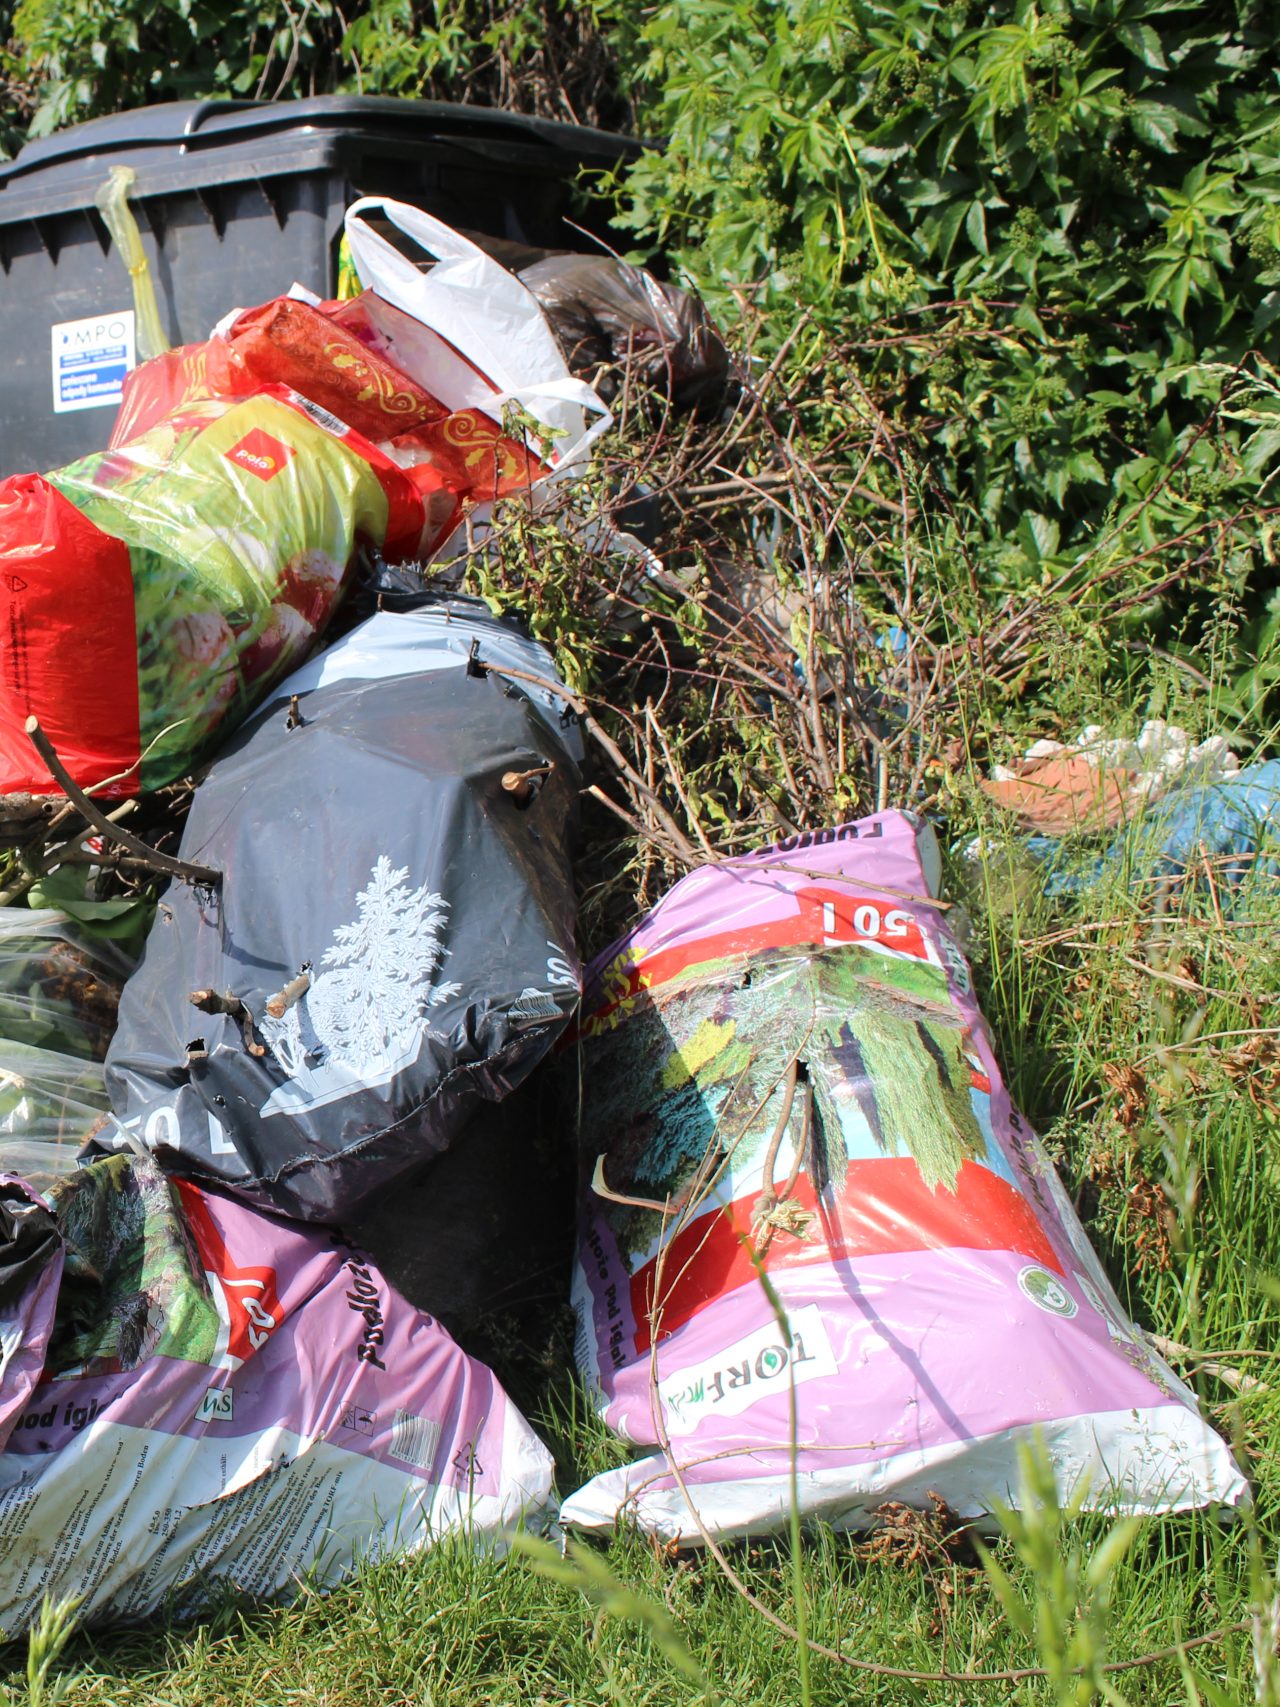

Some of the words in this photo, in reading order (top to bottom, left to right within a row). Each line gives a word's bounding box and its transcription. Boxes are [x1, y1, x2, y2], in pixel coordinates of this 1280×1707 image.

[853, 905, 915, 938] 50
[136, 1443, 149, 1469] Boden
[322, 1469, 344, 1507] TORF-mix
[14, 1550, 38, 1595] TORF-mix
